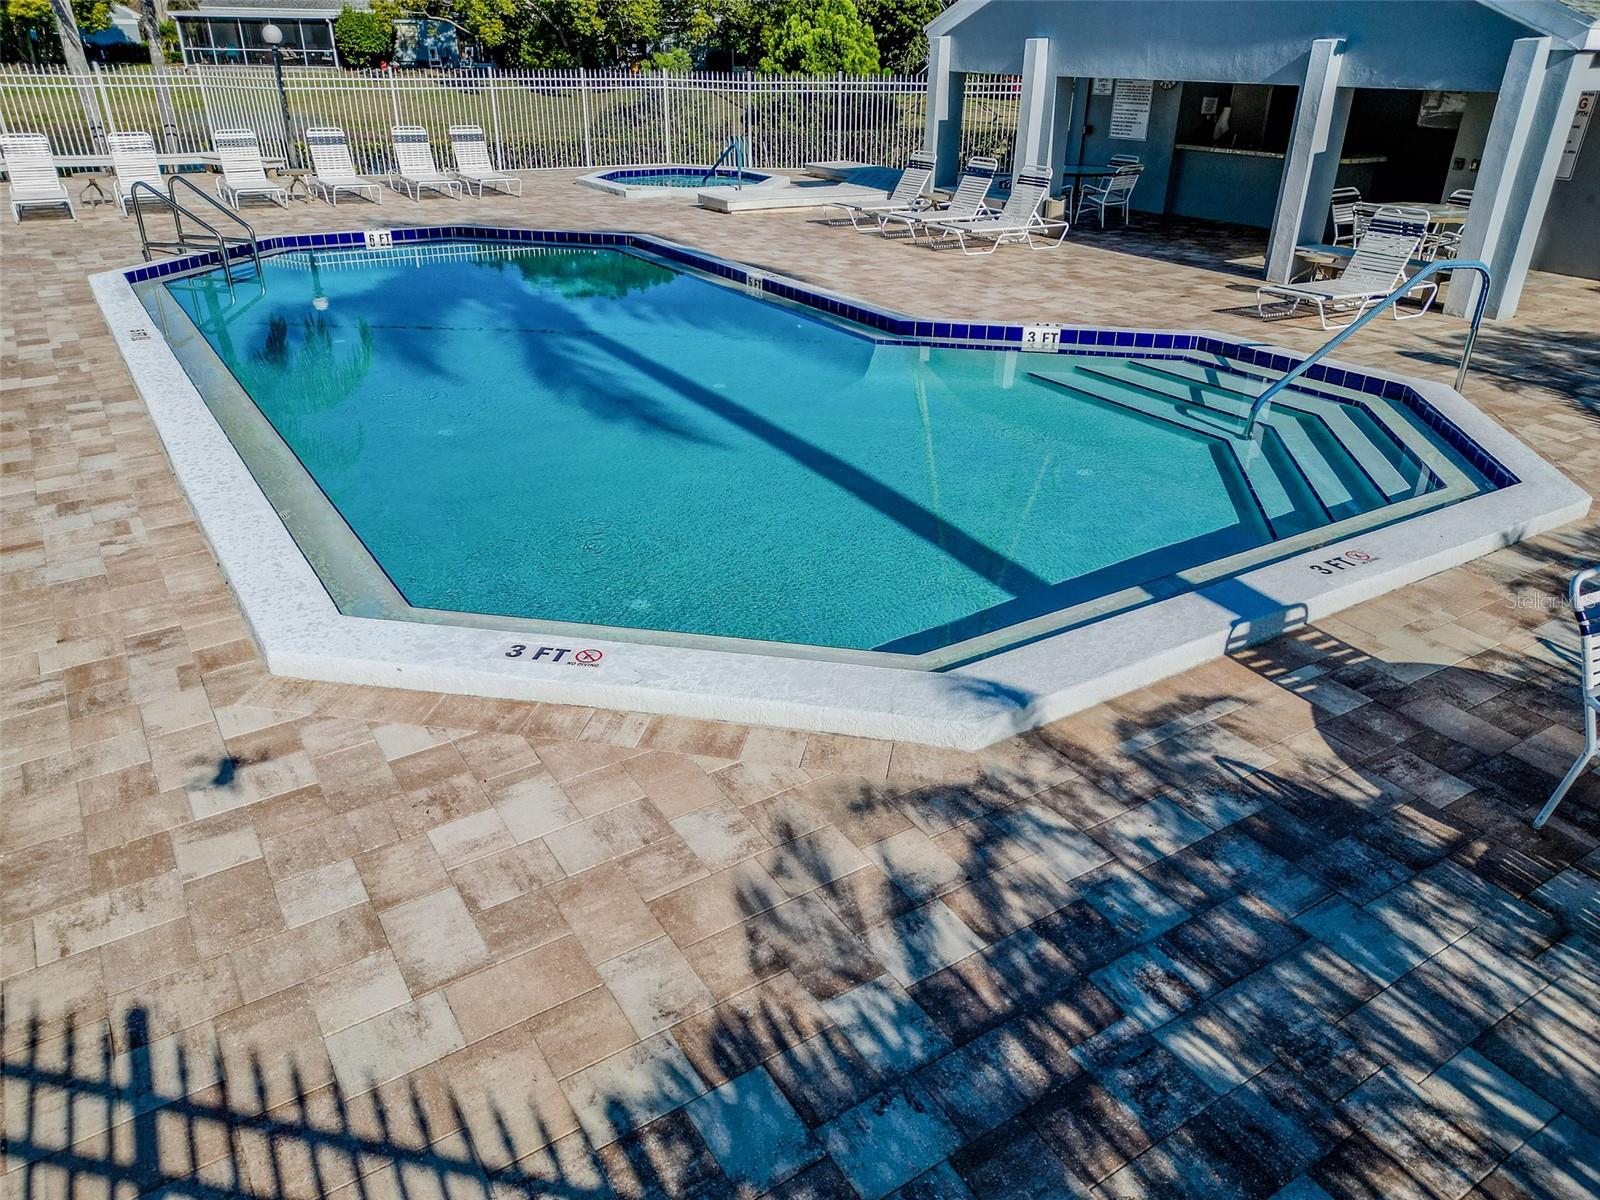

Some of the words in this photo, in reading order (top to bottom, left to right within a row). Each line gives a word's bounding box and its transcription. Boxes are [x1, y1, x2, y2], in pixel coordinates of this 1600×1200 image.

[368, 233, 376, 247] 6
[379, 233, 391, 246] FT
[748, 276, 753, 287] 5
[754, 279, 761, 290] FT
[1027, 331, 1036, 342] 3
[1042, 332, 1059, 343] FT
[1309, 564, 1333, 575] 3
[1323, 557, 1356, 570] FT
[505, 644, 526, 658] 3
[531, 646, 571, 662] FT
